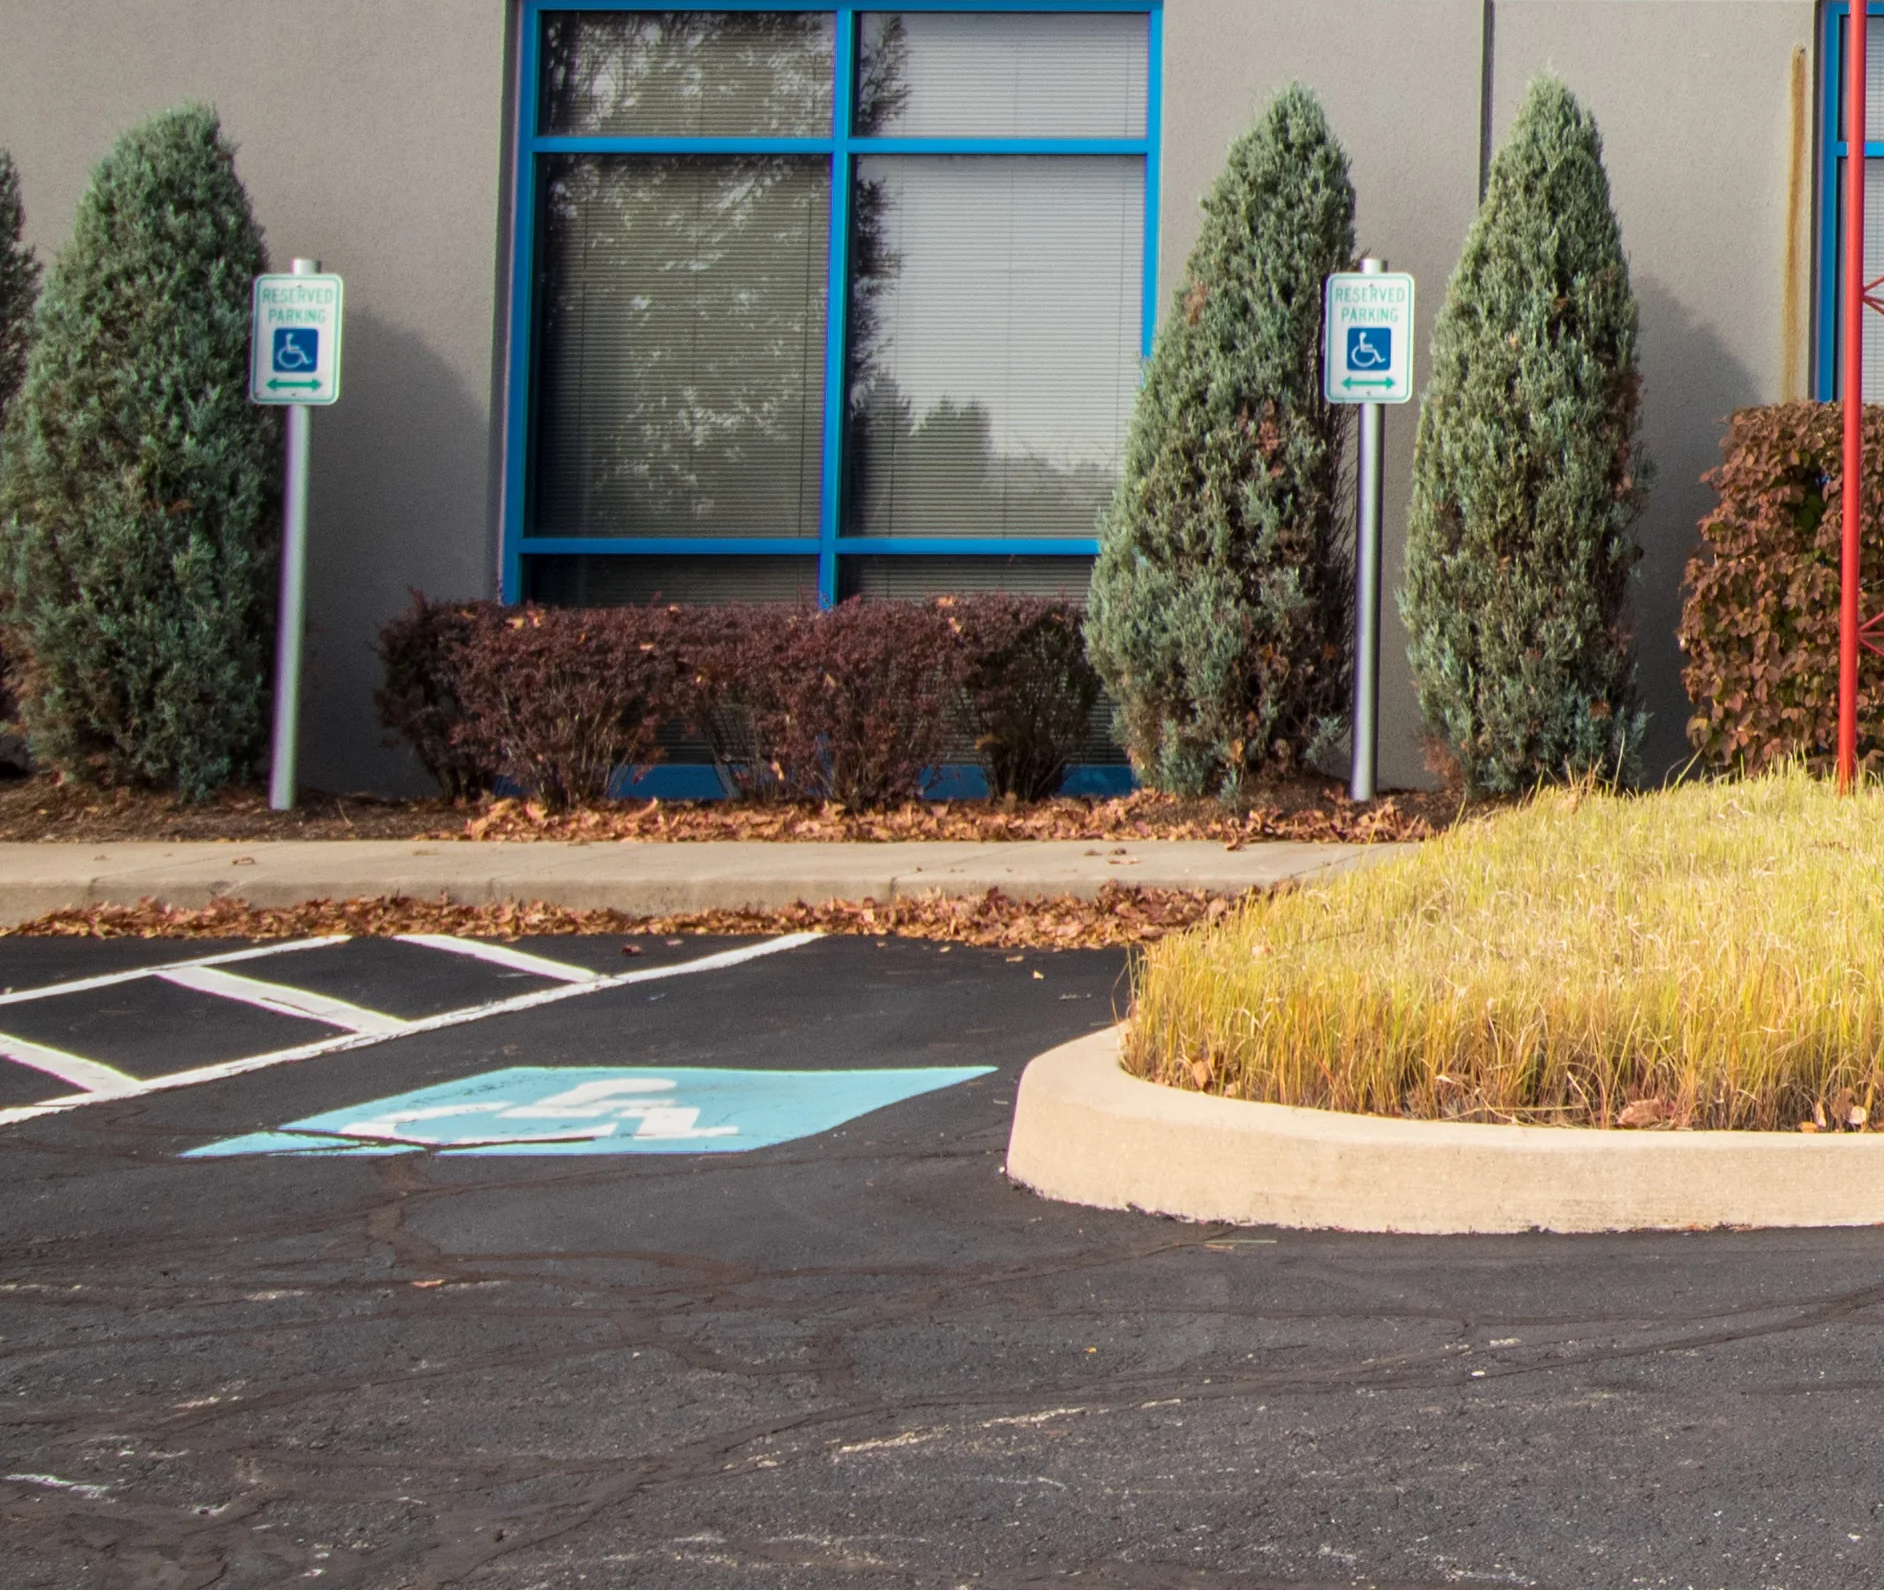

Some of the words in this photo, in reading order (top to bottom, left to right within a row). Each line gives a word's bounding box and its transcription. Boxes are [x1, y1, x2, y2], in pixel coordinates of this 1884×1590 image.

[262, 288, 334, 304] RESERVED
[1335, 287, 1405, 303] RESERVED
[268, 309, 326, 324] PARKING
[1341, 308, 1398, 322] PARKING
